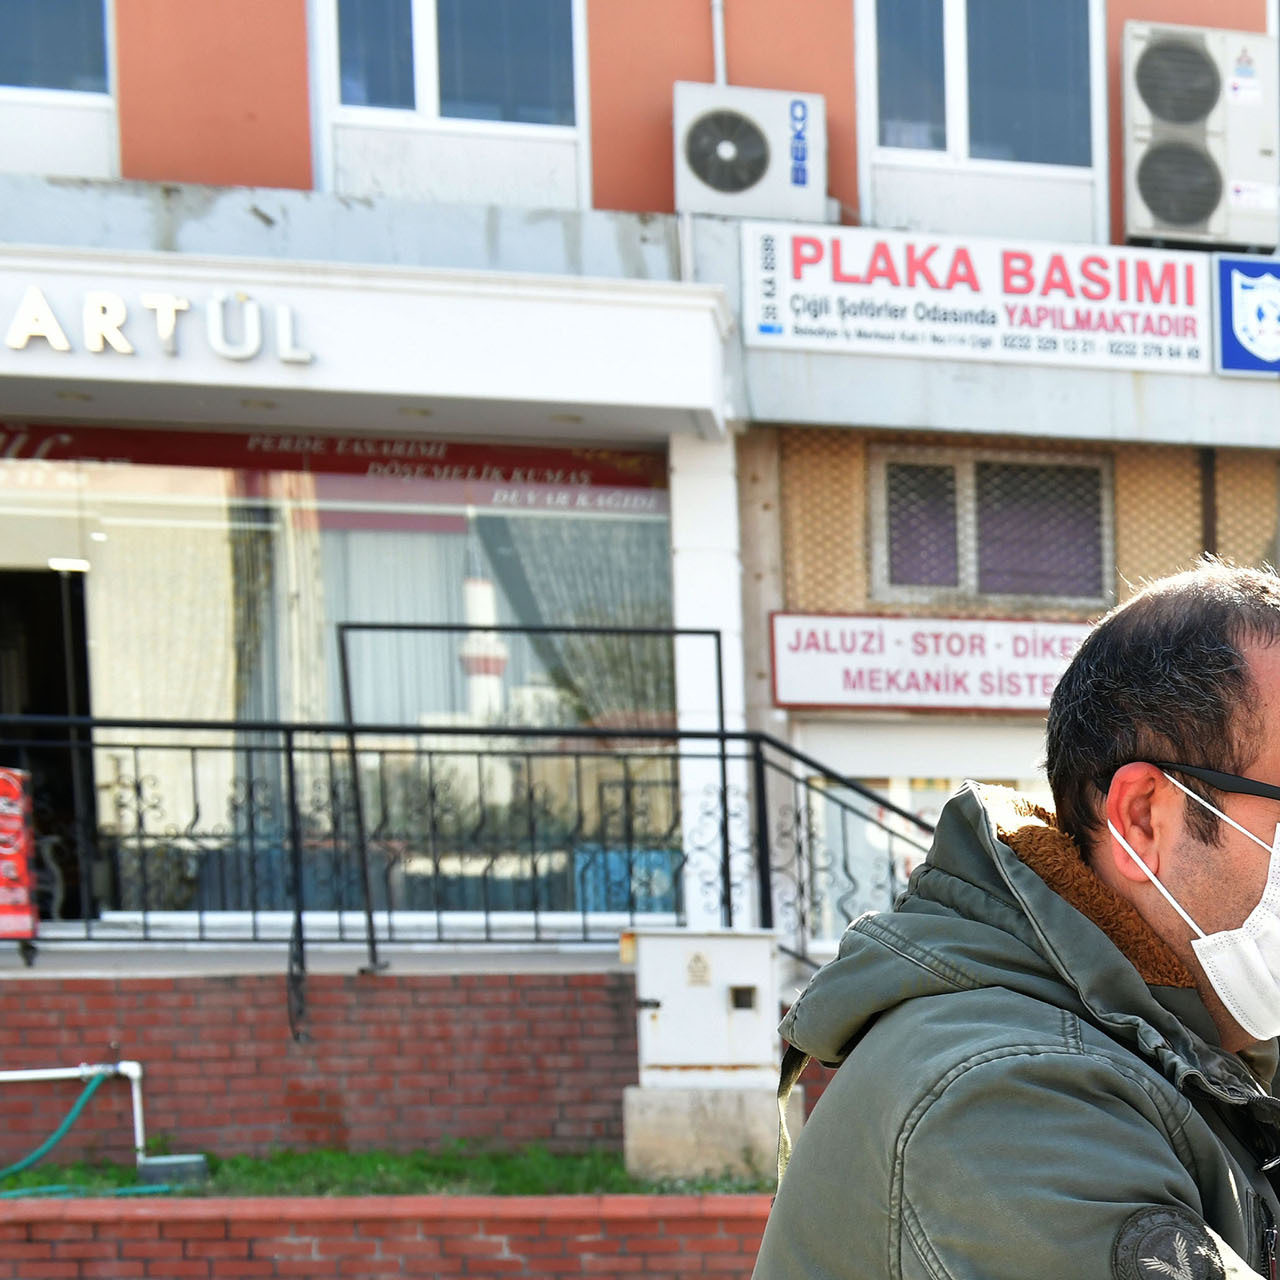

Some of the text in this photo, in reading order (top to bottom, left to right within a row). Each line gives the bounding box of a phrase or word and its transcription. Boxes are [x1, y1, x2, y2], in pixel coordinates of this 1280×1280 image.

[789, 100, 809, 187] BEKO
[791, 236, 1195, 306] PLAKA BASIMI
[837, 297, 907, 321] Şoförler
[914, 302, 997, 325] Odasında
[1005, 304, 1198, 338] YAPILMAKTADIR
[788, 625, 1083, 659] JALUZİ STOR DİKE
[843, 664, 1056, 697] MEKANİK SİSTE
